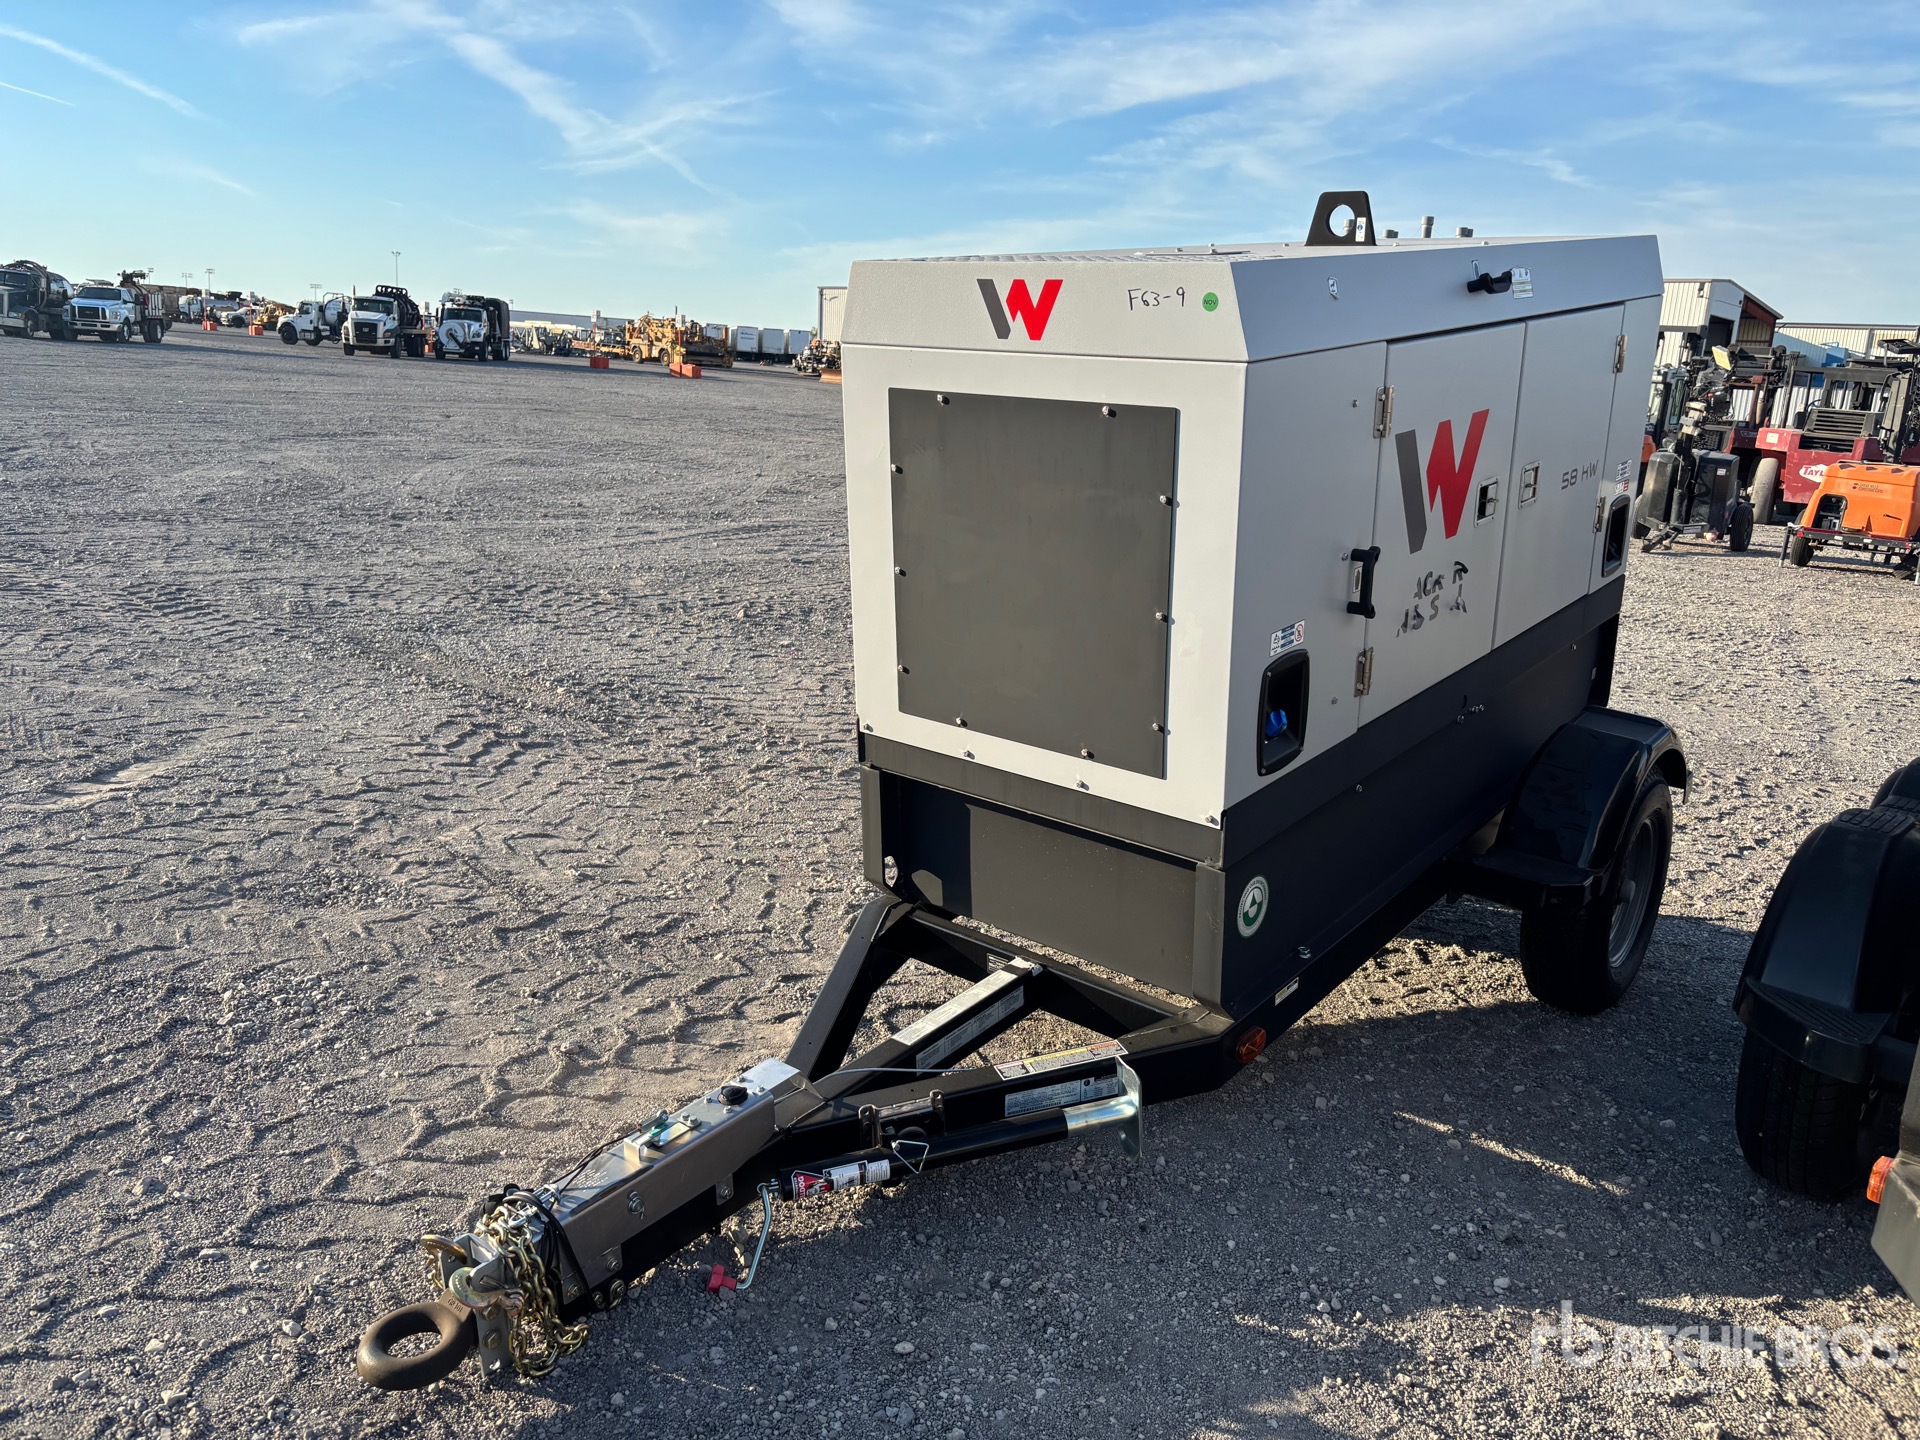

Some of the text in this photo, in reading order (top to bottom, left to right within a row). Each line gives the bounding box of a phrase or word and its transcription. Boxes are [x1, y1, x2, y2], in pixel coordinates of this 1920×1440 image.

[1127, 286, 1185, 311] F63-9
[1203, 298, 1217, 306] NOV
[1561, 468, 1578, 491] 58
[1803, 466, 1824, 477] TAYL
[797, 1175, 806, 1200] LLDOG
